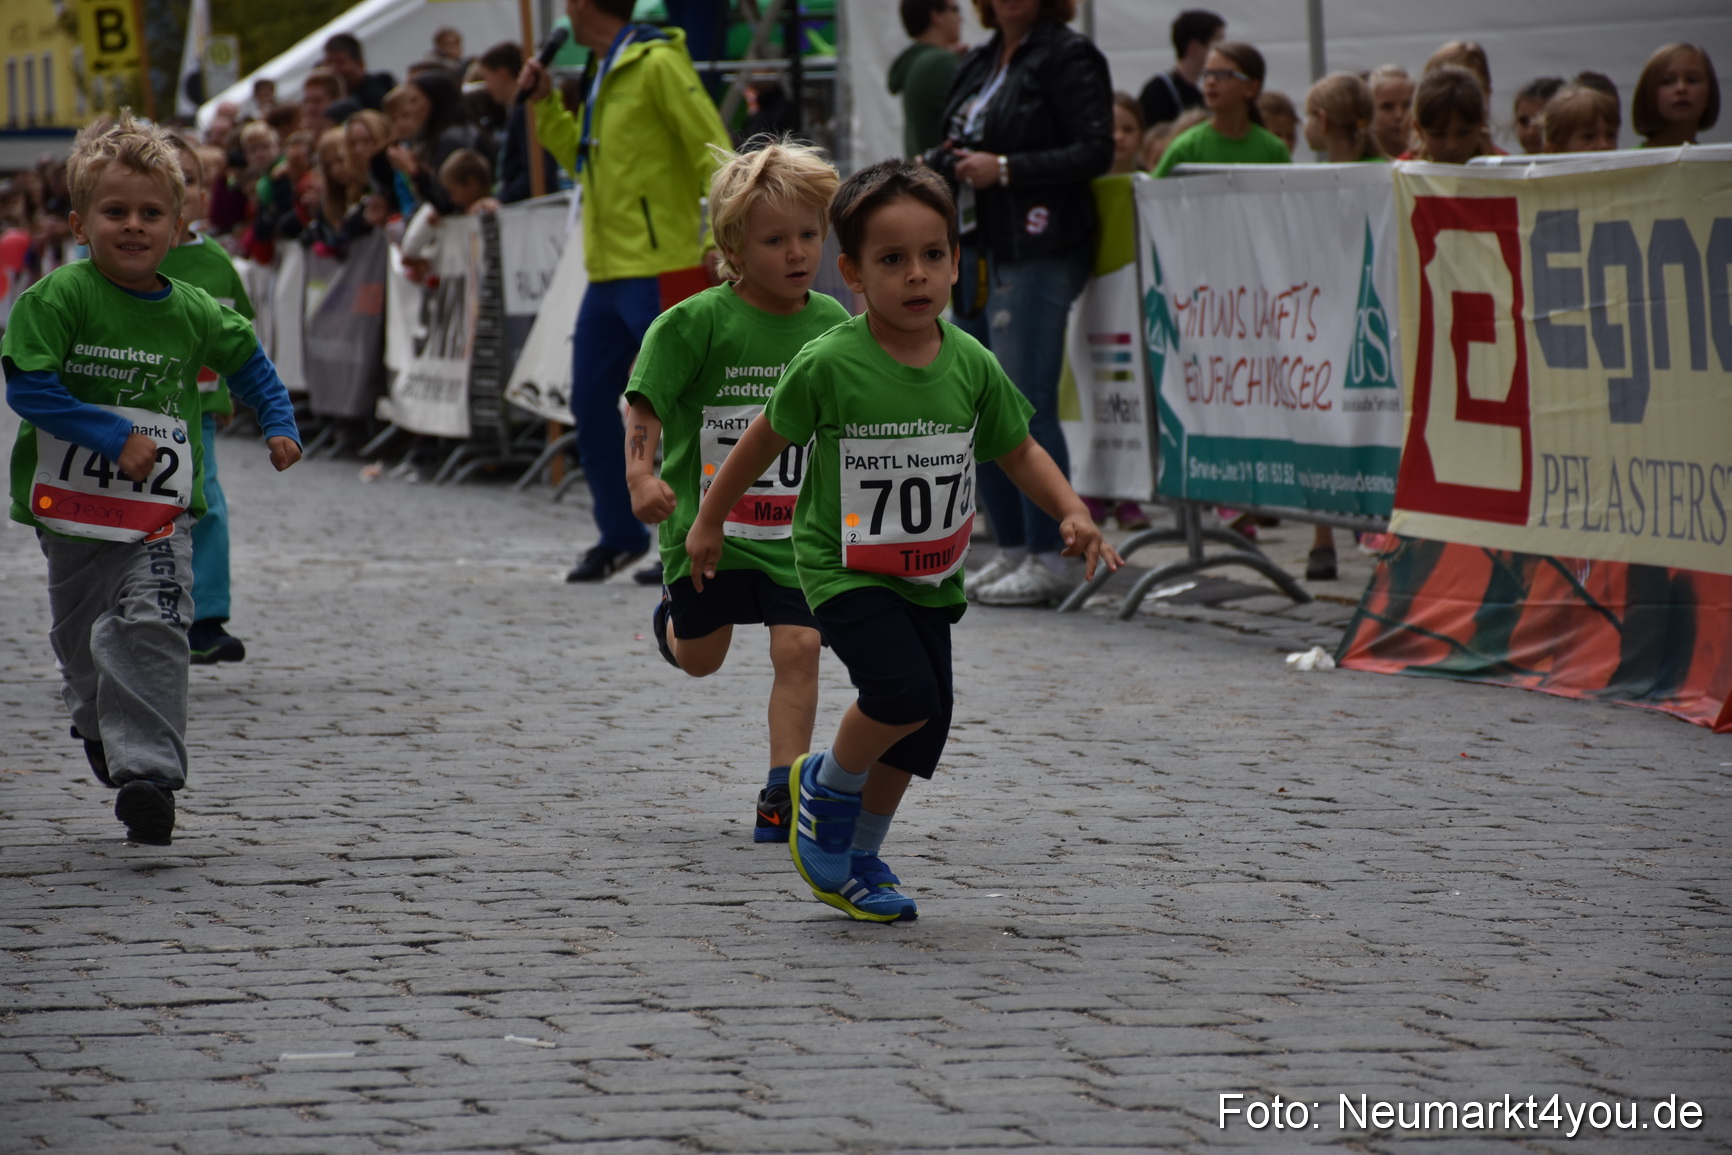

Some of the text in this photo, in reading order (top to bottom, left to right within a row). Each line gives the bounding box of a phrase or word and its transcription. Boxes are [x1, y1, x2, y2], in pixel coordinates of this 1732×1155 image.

[95, 8, 130, 52] B
[845, 419, 952, 438] Neumarkter
[845, 455, 903, 470] PARTL
[860, 463, 972, 536] 7075
[754, 502, 793, 521] Max
[900, 545, 957, 571] Timur
